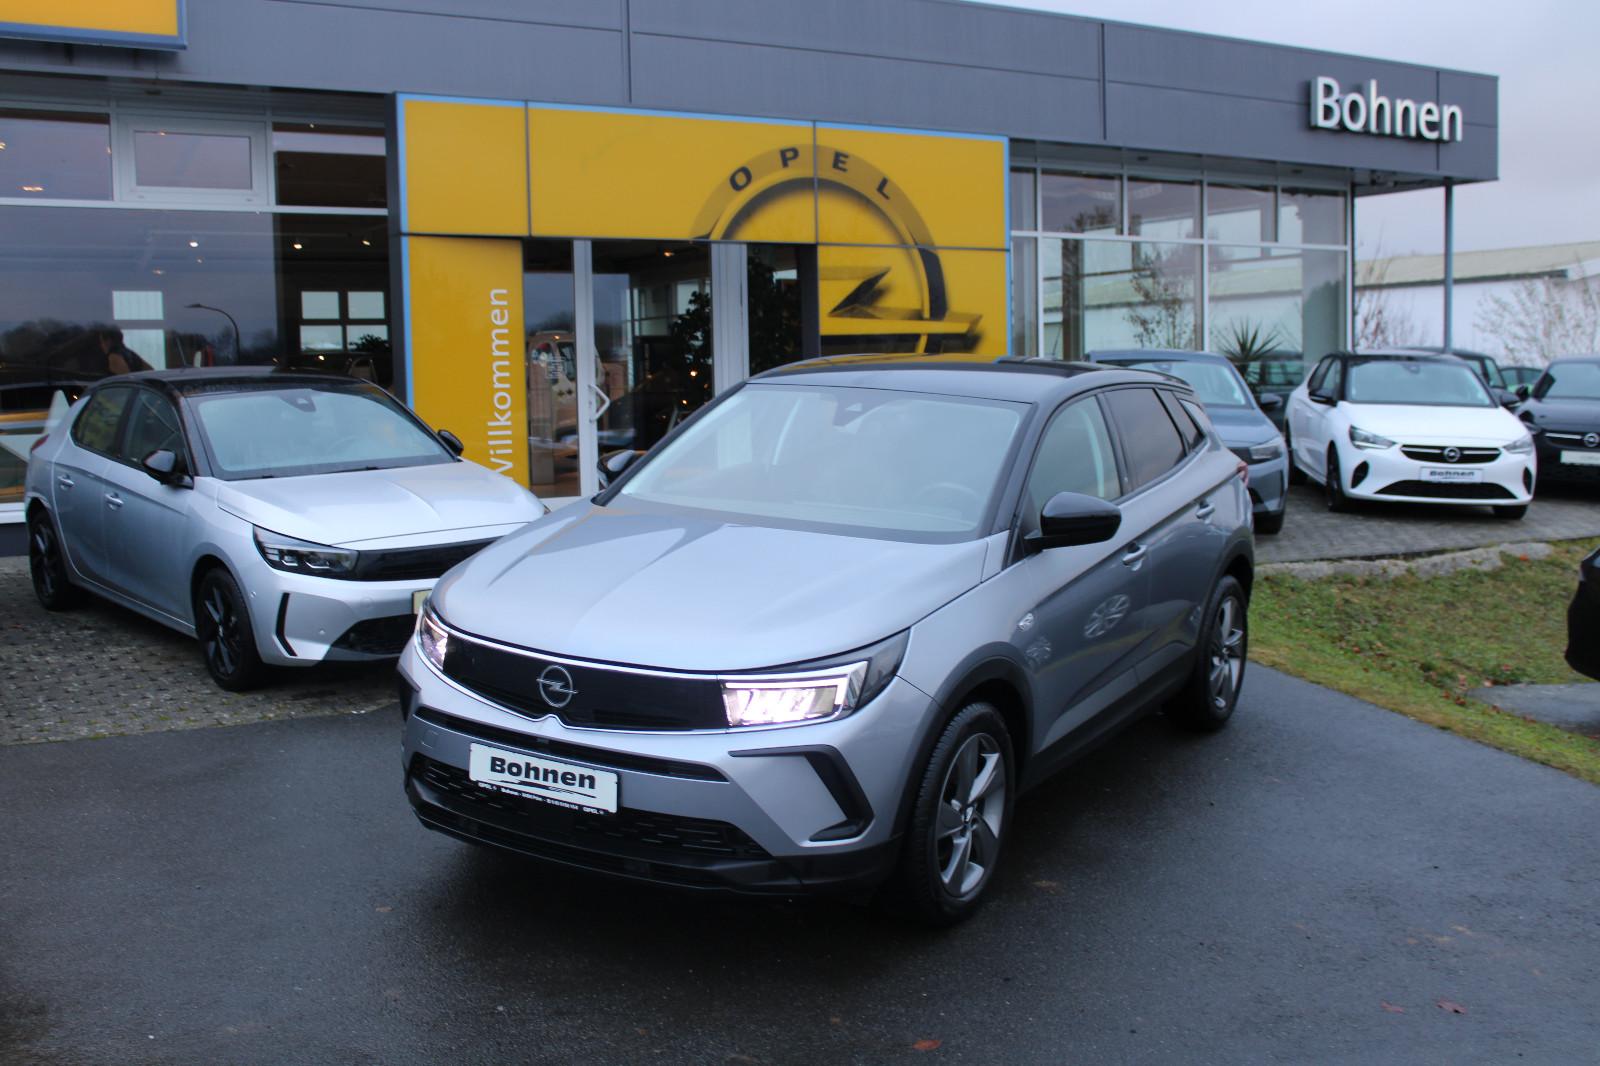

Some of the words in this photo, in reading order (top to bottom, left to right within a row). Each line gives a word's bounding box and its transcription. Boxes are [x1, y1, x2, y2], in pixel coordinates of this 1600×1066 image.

[1312, 75, 1463, 143] Bohnen
[728, 146, 891, 200] OPEL
[490, 755, 596, 790] Bohnen
